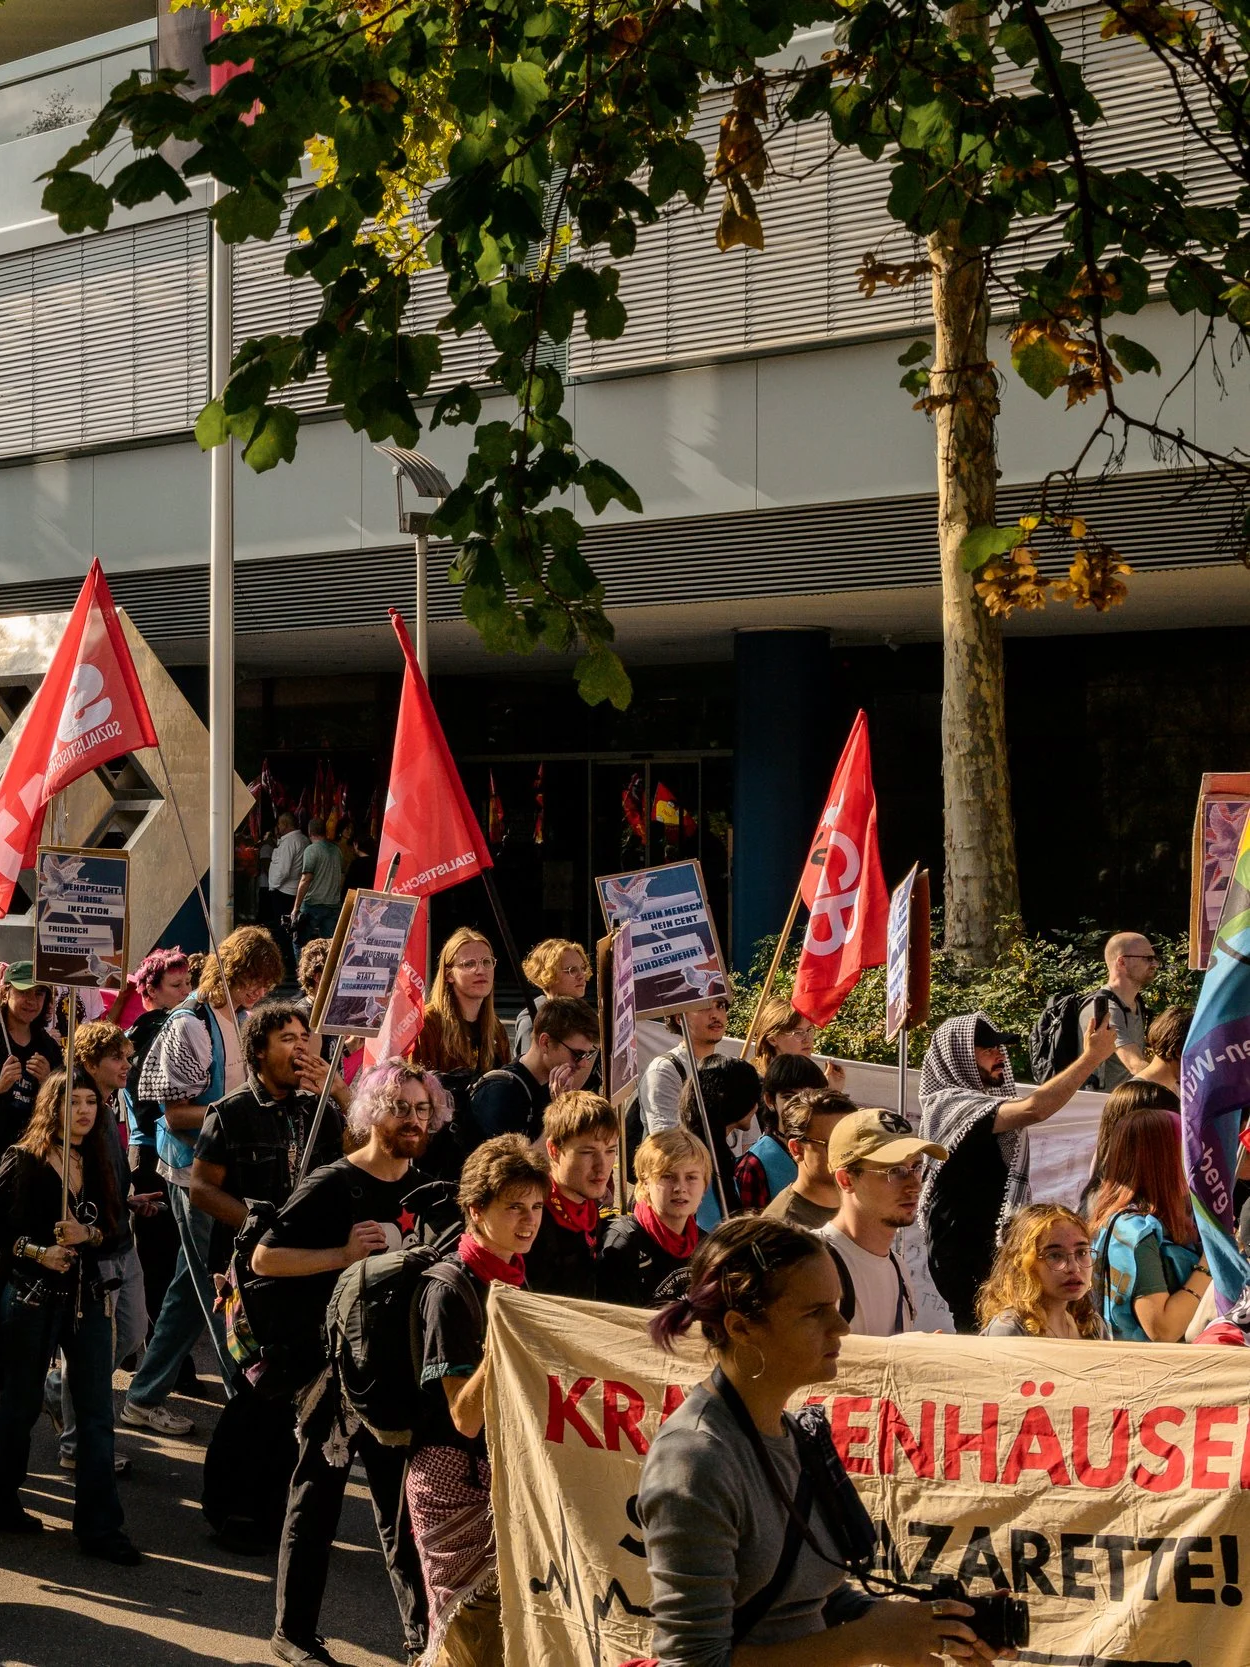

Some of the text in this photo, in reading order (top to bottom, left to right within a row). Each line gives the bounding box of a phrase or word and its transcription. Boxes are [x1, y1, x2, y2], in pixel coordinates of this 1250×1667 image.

[664, 902, 704, 917] MENSCH
[674, 914, 699, 926] CENT
[48, 925, 89, 934] FRIEDRICH
[57, 935, 78, 943] MERZ
[651, 942, 672, 955] DER
[361, 950, 399, 961] WIDERSTAND
[356, 971, 376, 981] STATT
[544, 1374, 1250, 1493] KRENHÄUSE
[869, 1518, 1243, 1607] AZARETTE!
